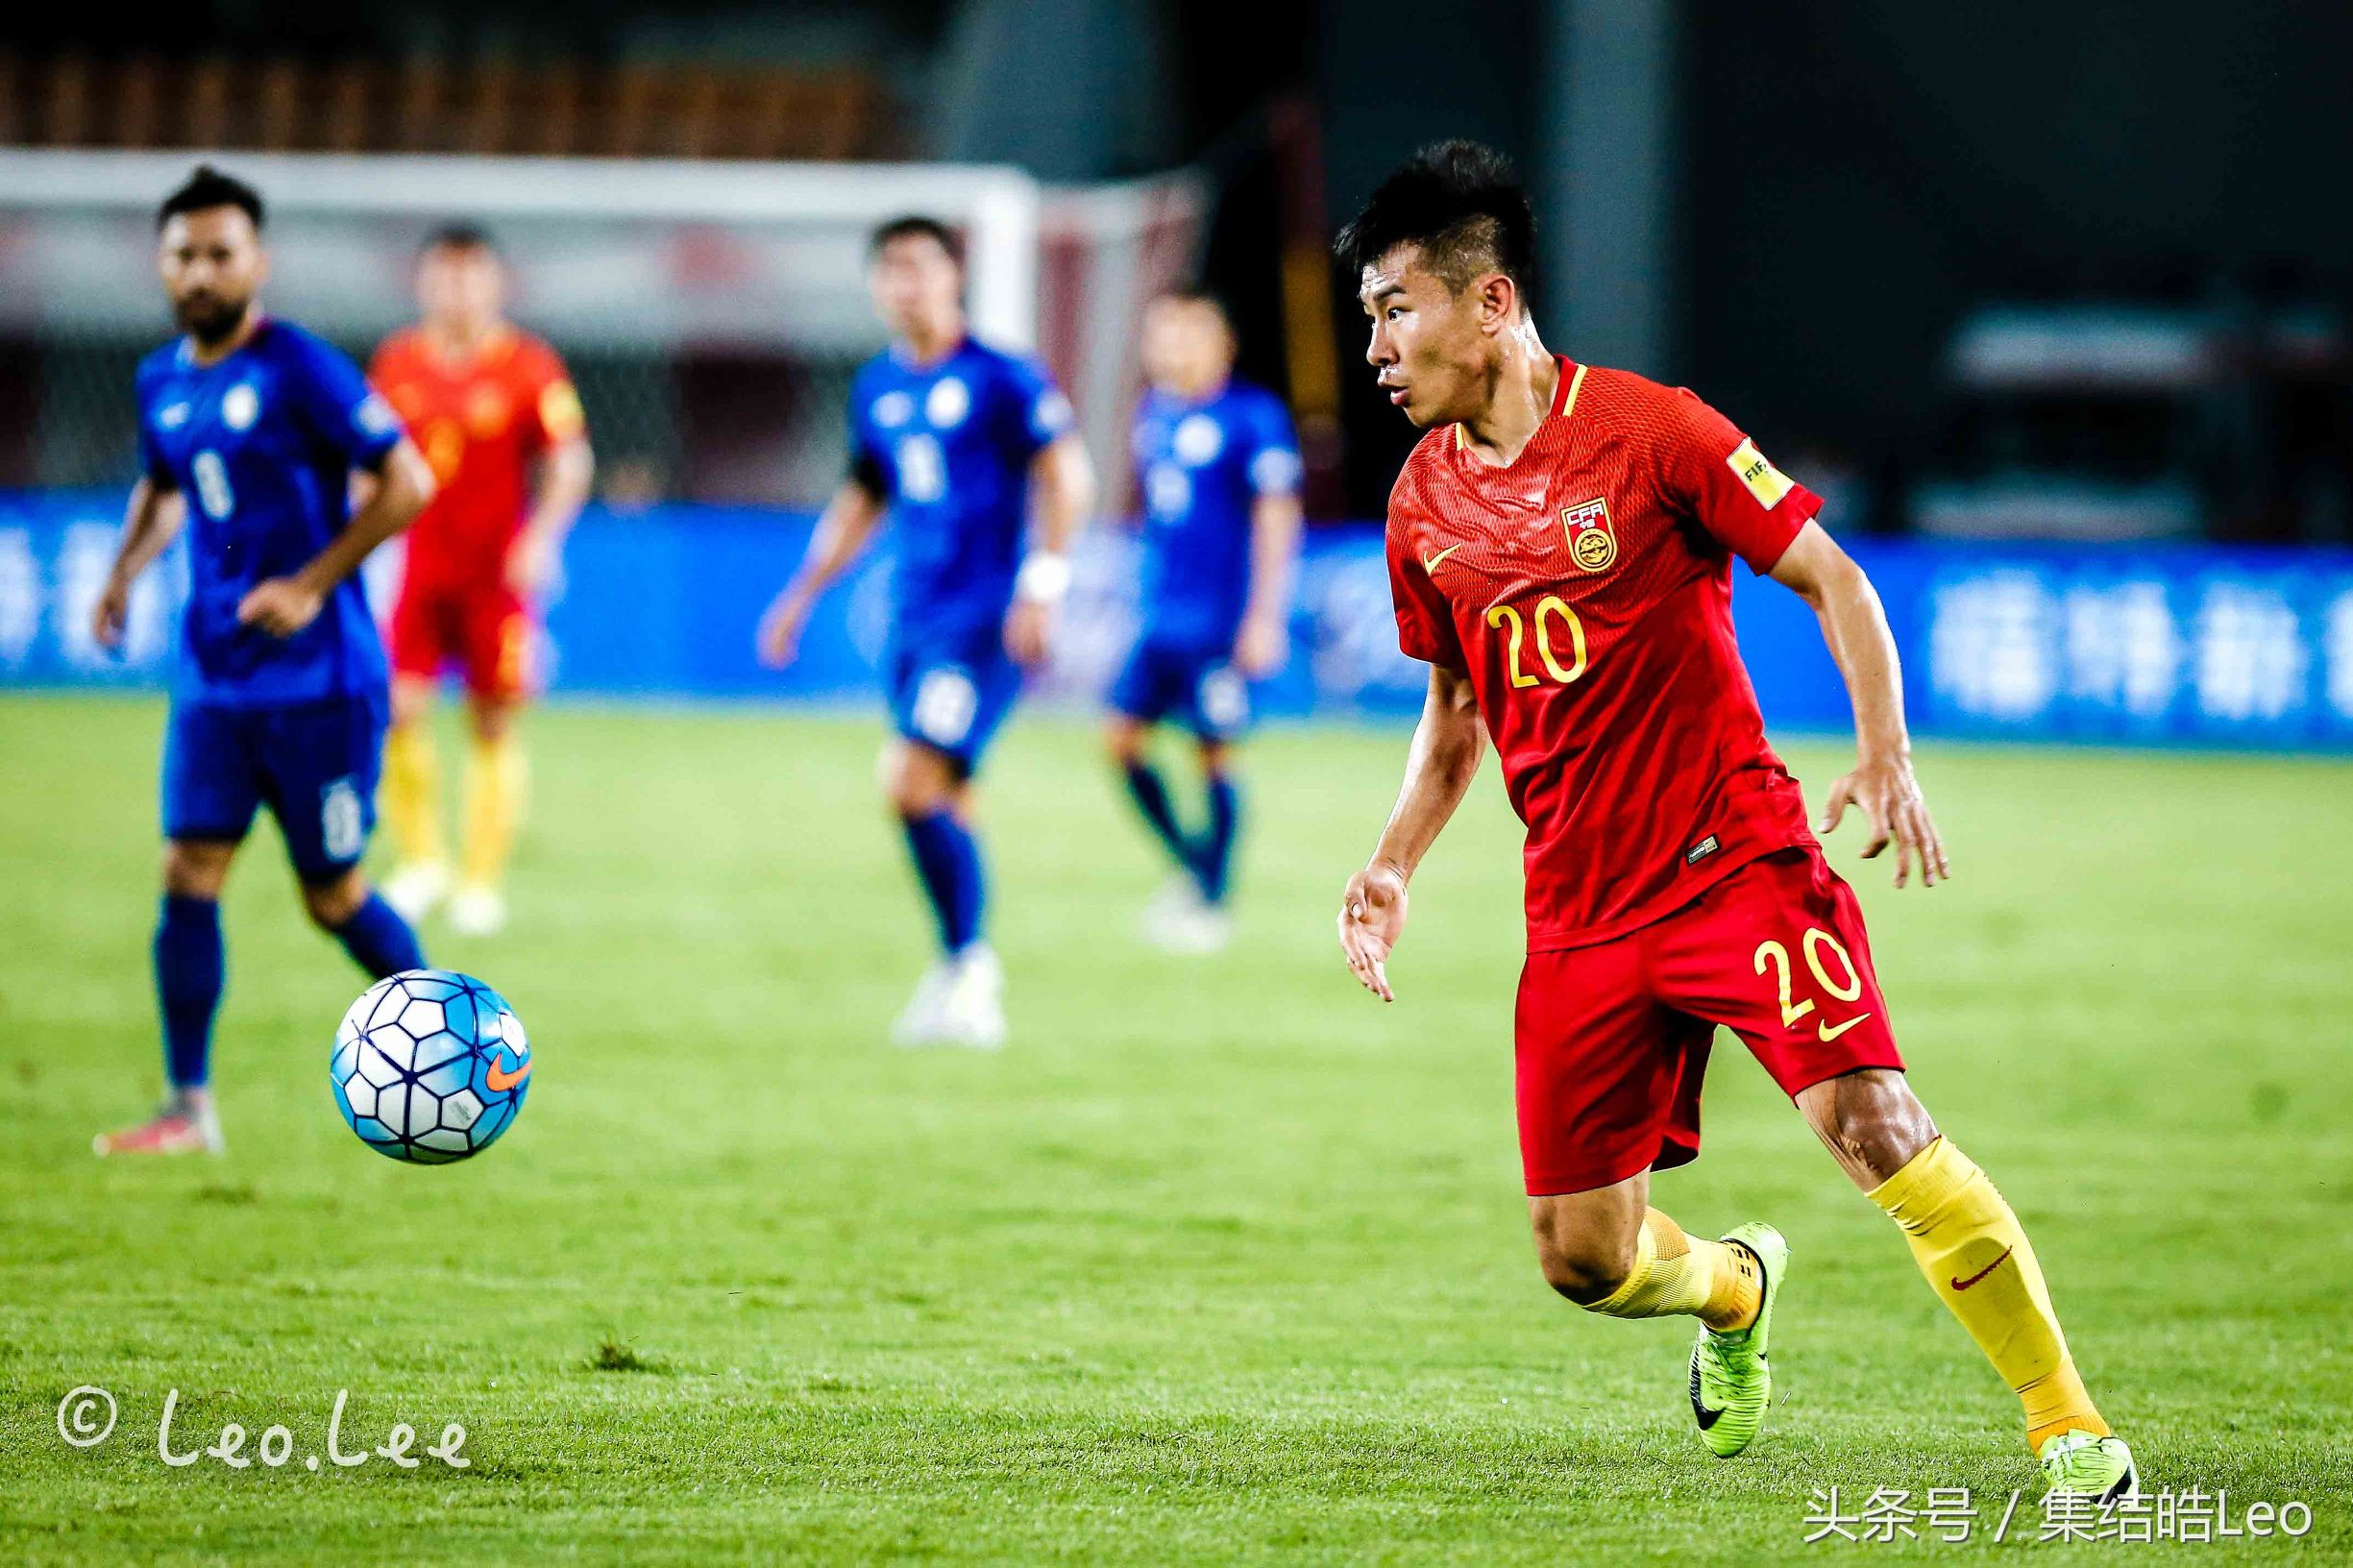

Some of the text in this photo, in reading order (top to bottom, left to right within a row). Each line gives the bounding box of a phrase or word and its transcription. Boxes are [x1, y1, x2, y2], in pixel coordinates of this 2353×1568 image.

[1745, 460, 1767, 482] FIF
[1565, 502, 1605, 527] CFA
[1486, 596, 1587, 689] 20
[1753, 927, 1862, 1029] 20
